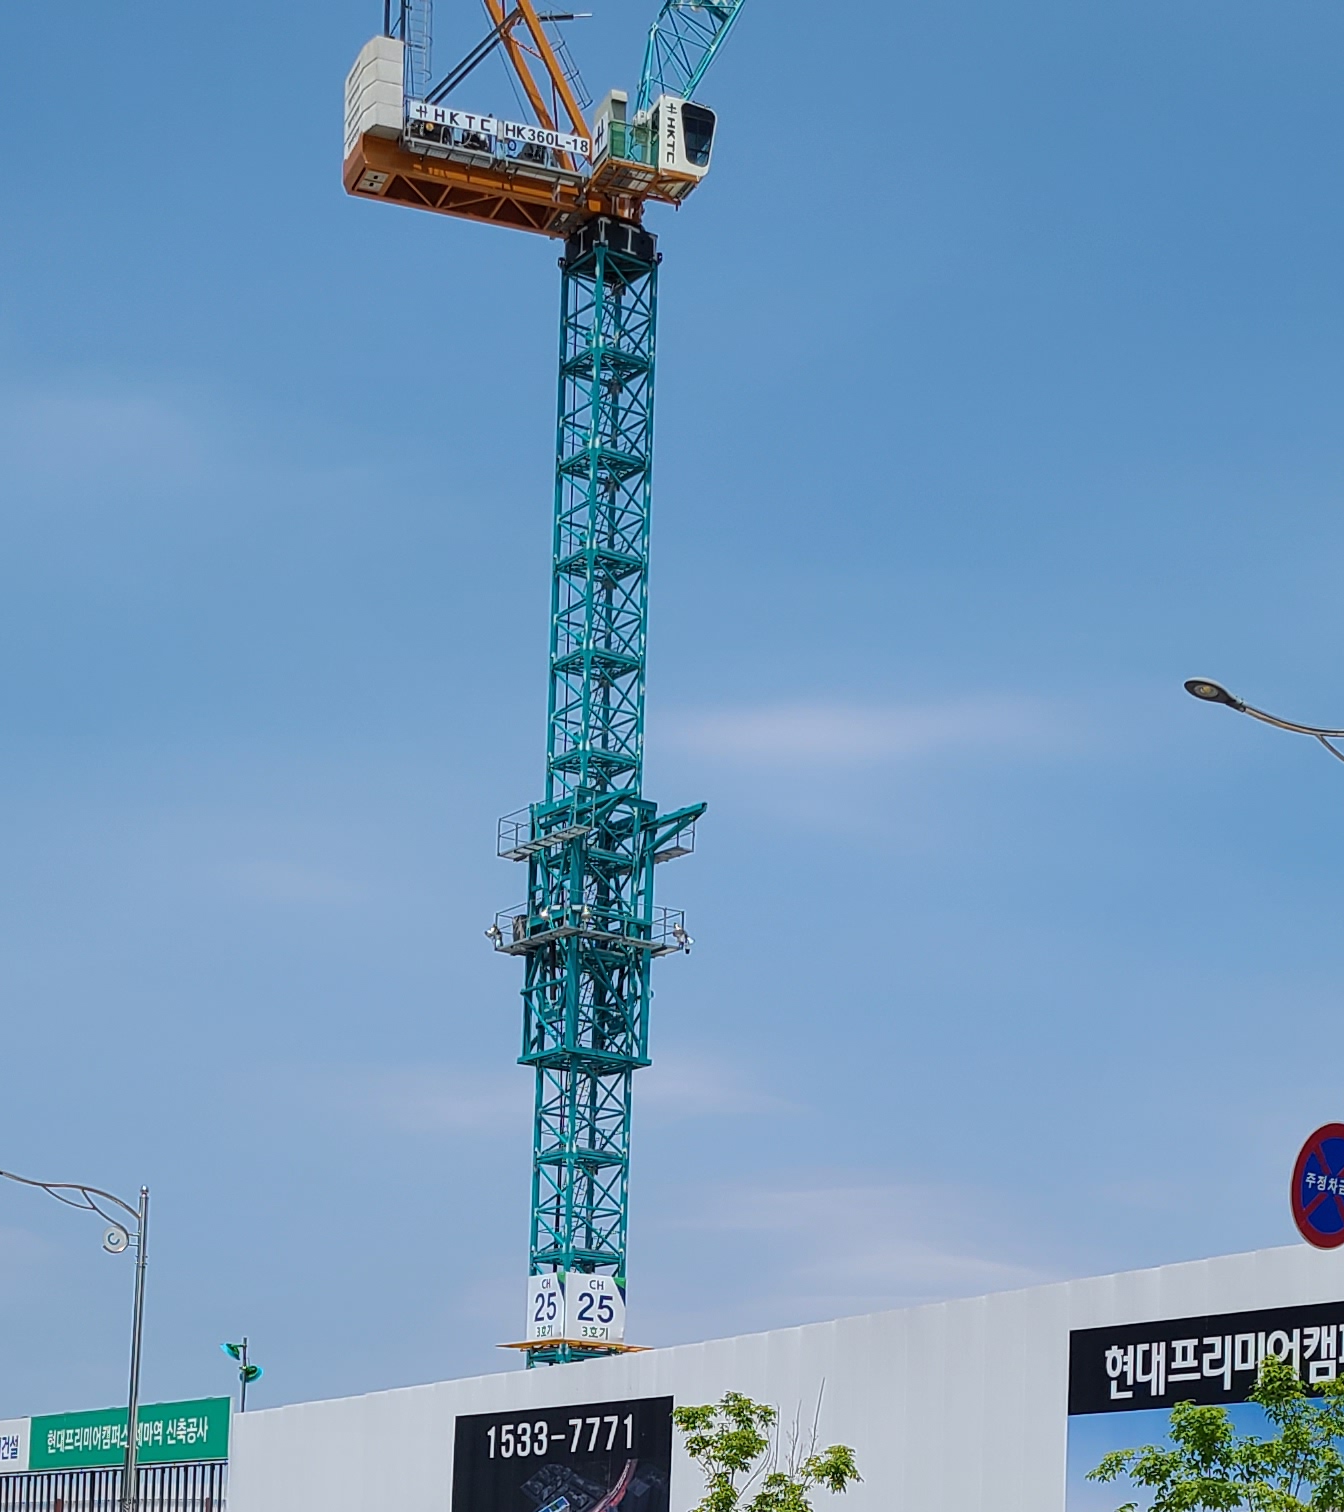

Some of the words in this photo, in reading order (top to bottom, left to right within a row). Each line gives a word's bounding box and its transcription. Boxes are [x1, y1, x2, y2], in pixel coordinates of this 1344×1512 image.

[434, 107, 491, 133] HKTC
[505, 122, 589, 154] HK360L-18
[666, 116, 676, 165] HKTC
[541, 1278, 552, 1290] CH
[589, 1279, 605, 1291] CH
[534, 1291, 557, 1322] 25
[577, 1292, 614, 1324] 25
[536, 1324, 553, 1338] 3호기
[582, 1326, 609, 1341] 3호기
[166, 1416, 209, 1447] 신축공사
[487, 1413, 634, 1459] 1533-7771
